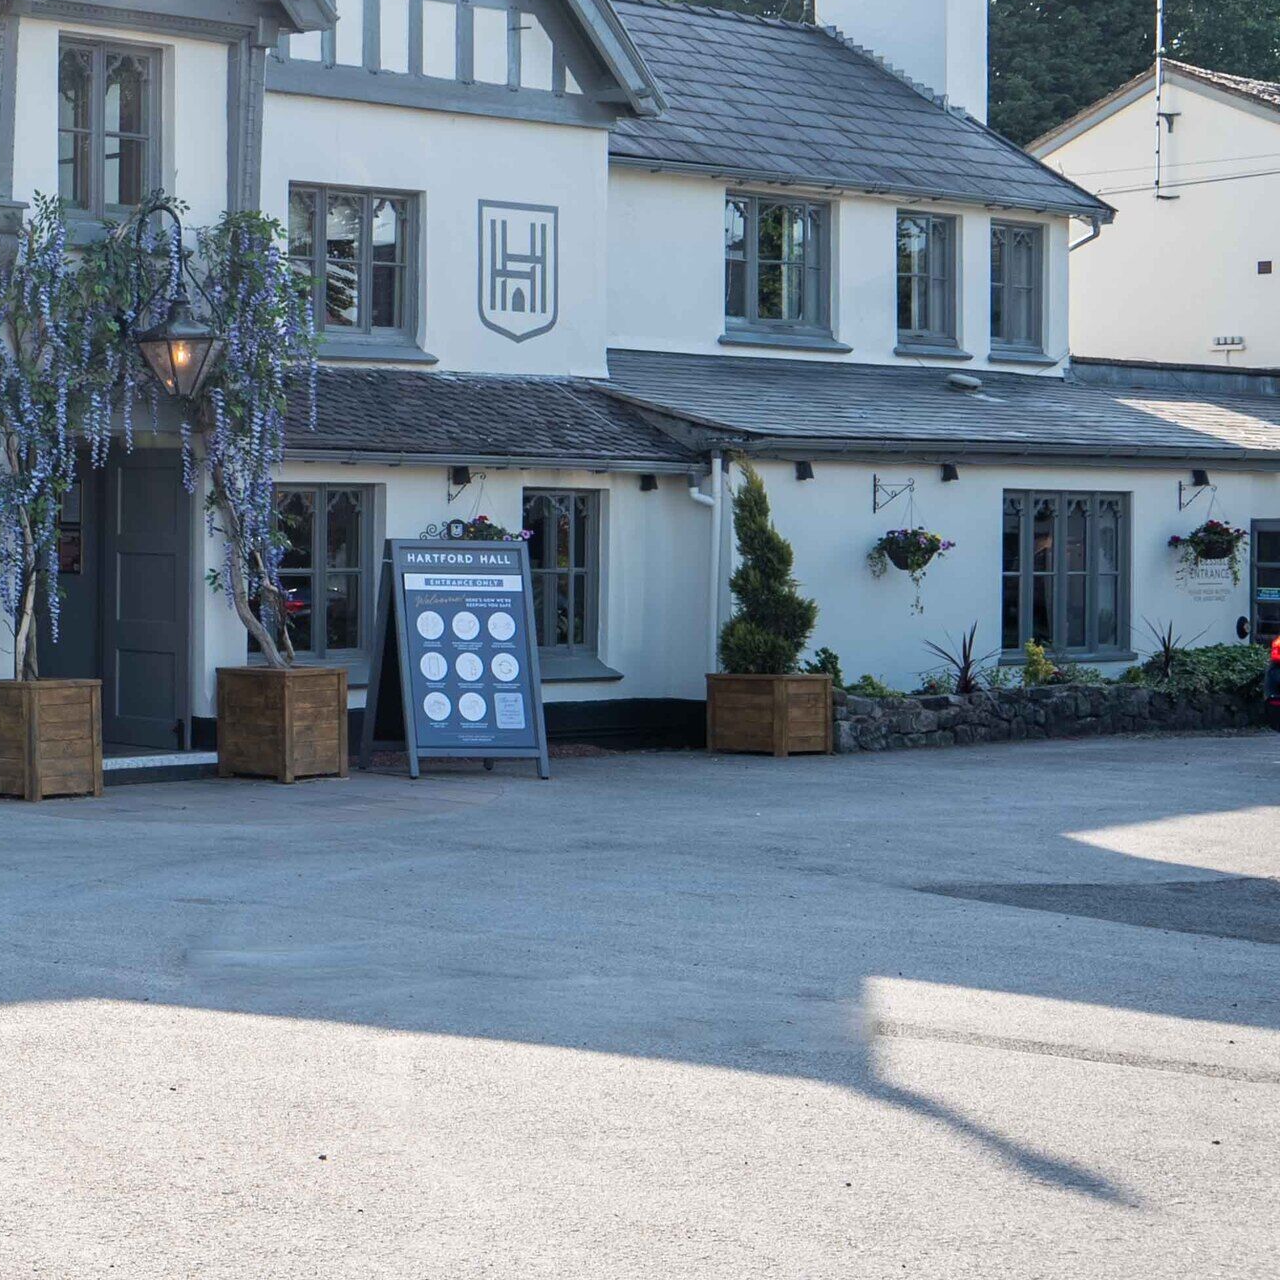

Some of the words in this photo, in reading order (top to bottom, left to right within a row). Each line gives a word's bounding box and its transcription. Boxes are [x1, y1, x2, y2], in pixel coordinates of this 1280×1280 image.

[407, 553, 474, 564] HARTFORD
[480, 554, 511, 565] HALL
[429, 578, 473, 586] ENTRANCE
[476, 579, 499, 587] ONLY
